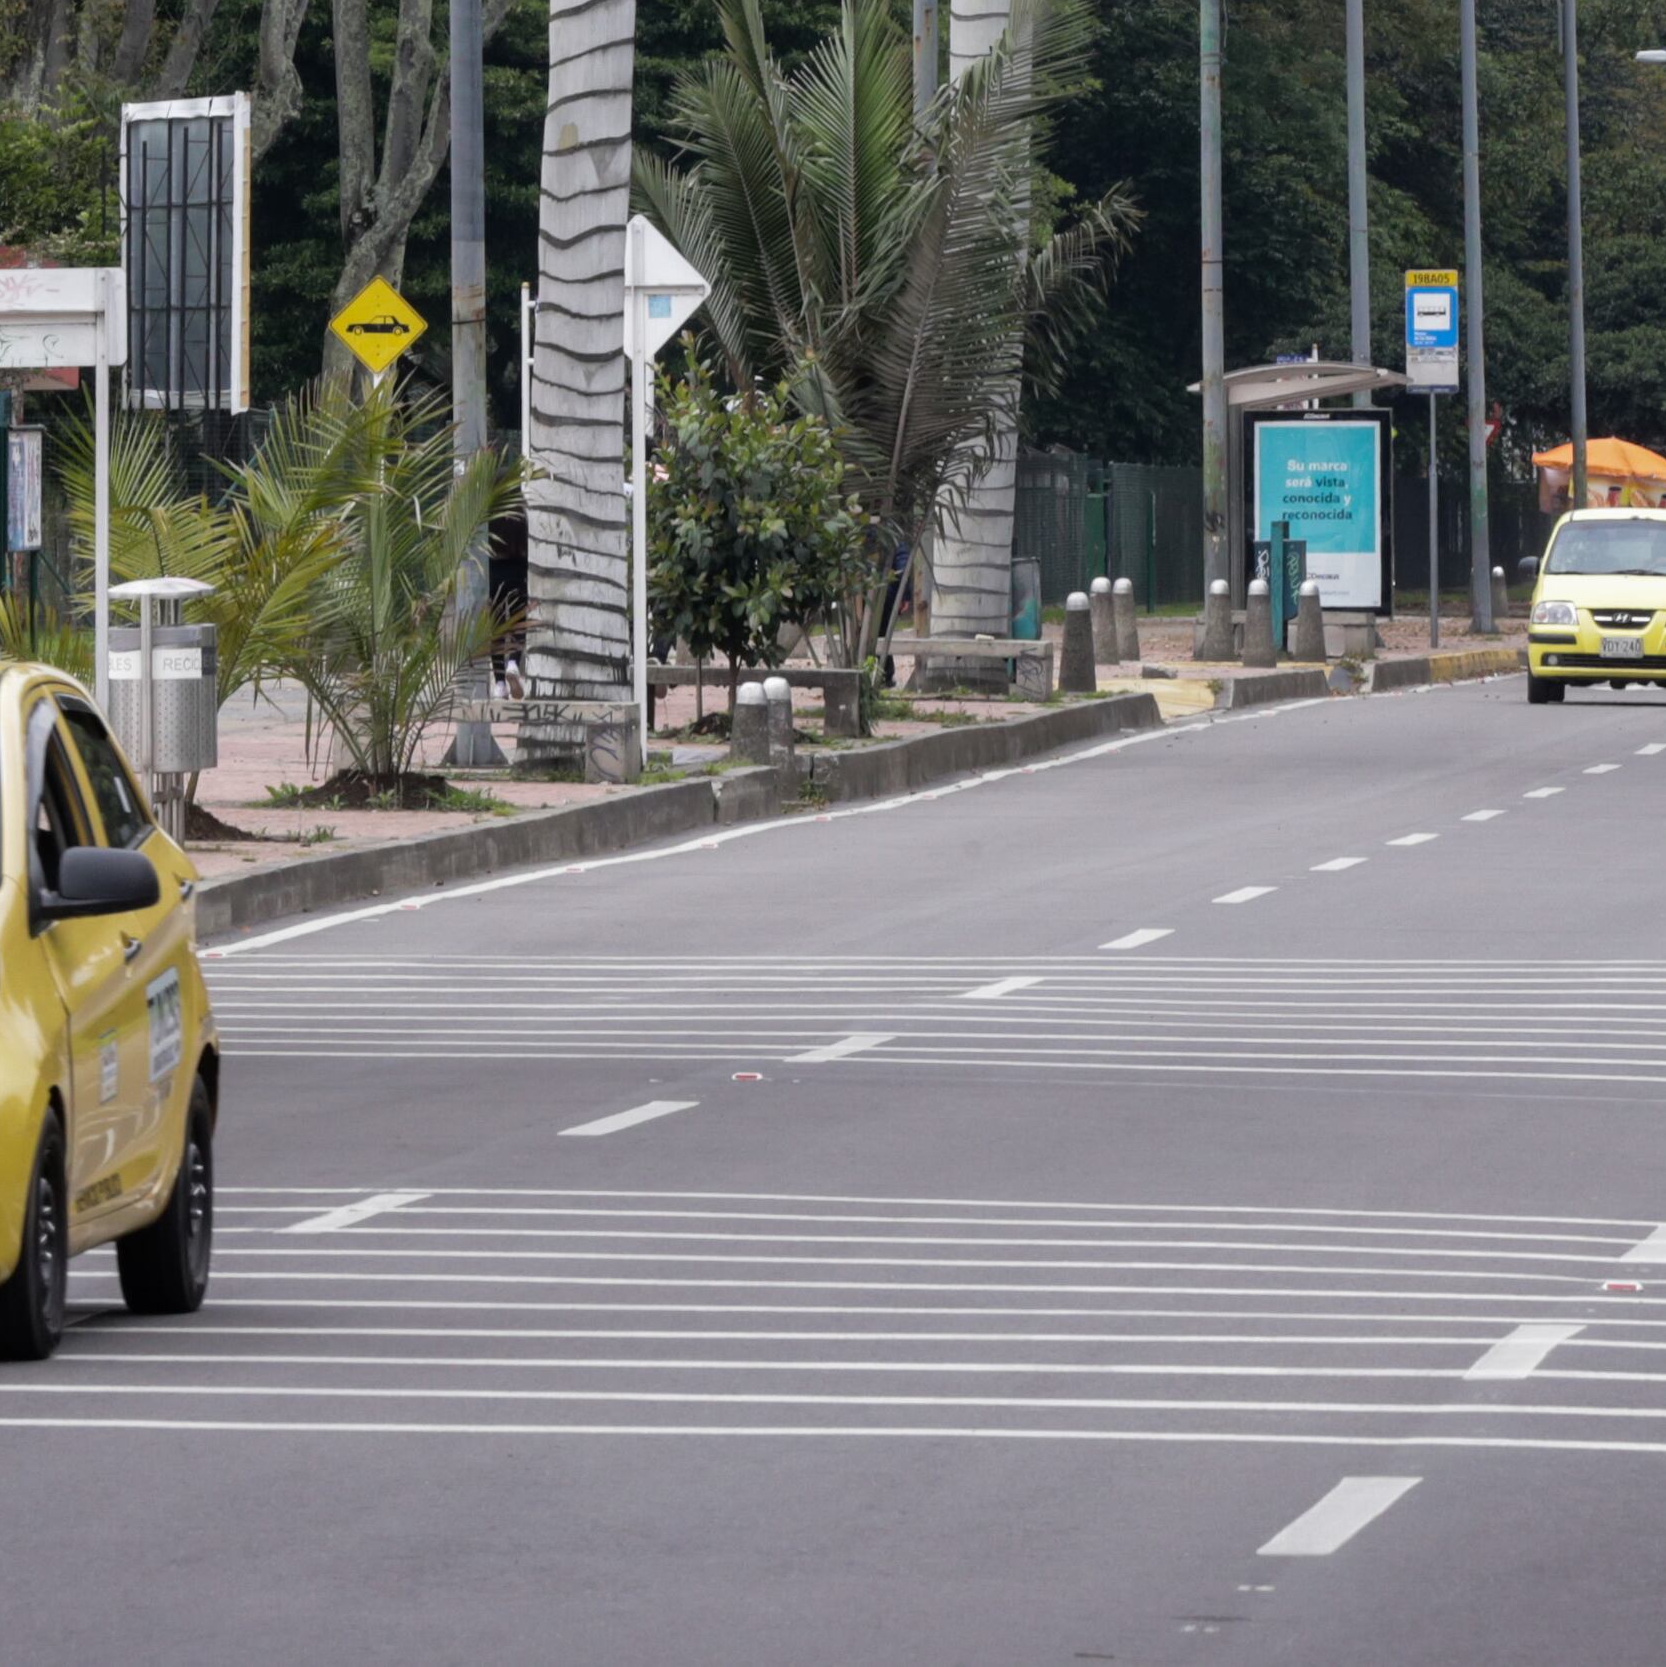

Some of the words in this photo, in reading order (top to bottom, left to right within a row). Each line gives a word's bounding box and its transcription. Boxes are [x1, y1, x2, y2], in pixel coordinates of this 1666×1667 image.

[1287, 459, 1305, 472] Su
[1308, 460, 1348, 472] marca
[1285, 475, 1312, 488] será
[1315, 475, 1349, 489] vista,
[1283, 492, 1340, 504] conocida
[1343, 494, 1351, 506] y
[1282, 508, 1353, 521] reconocida
